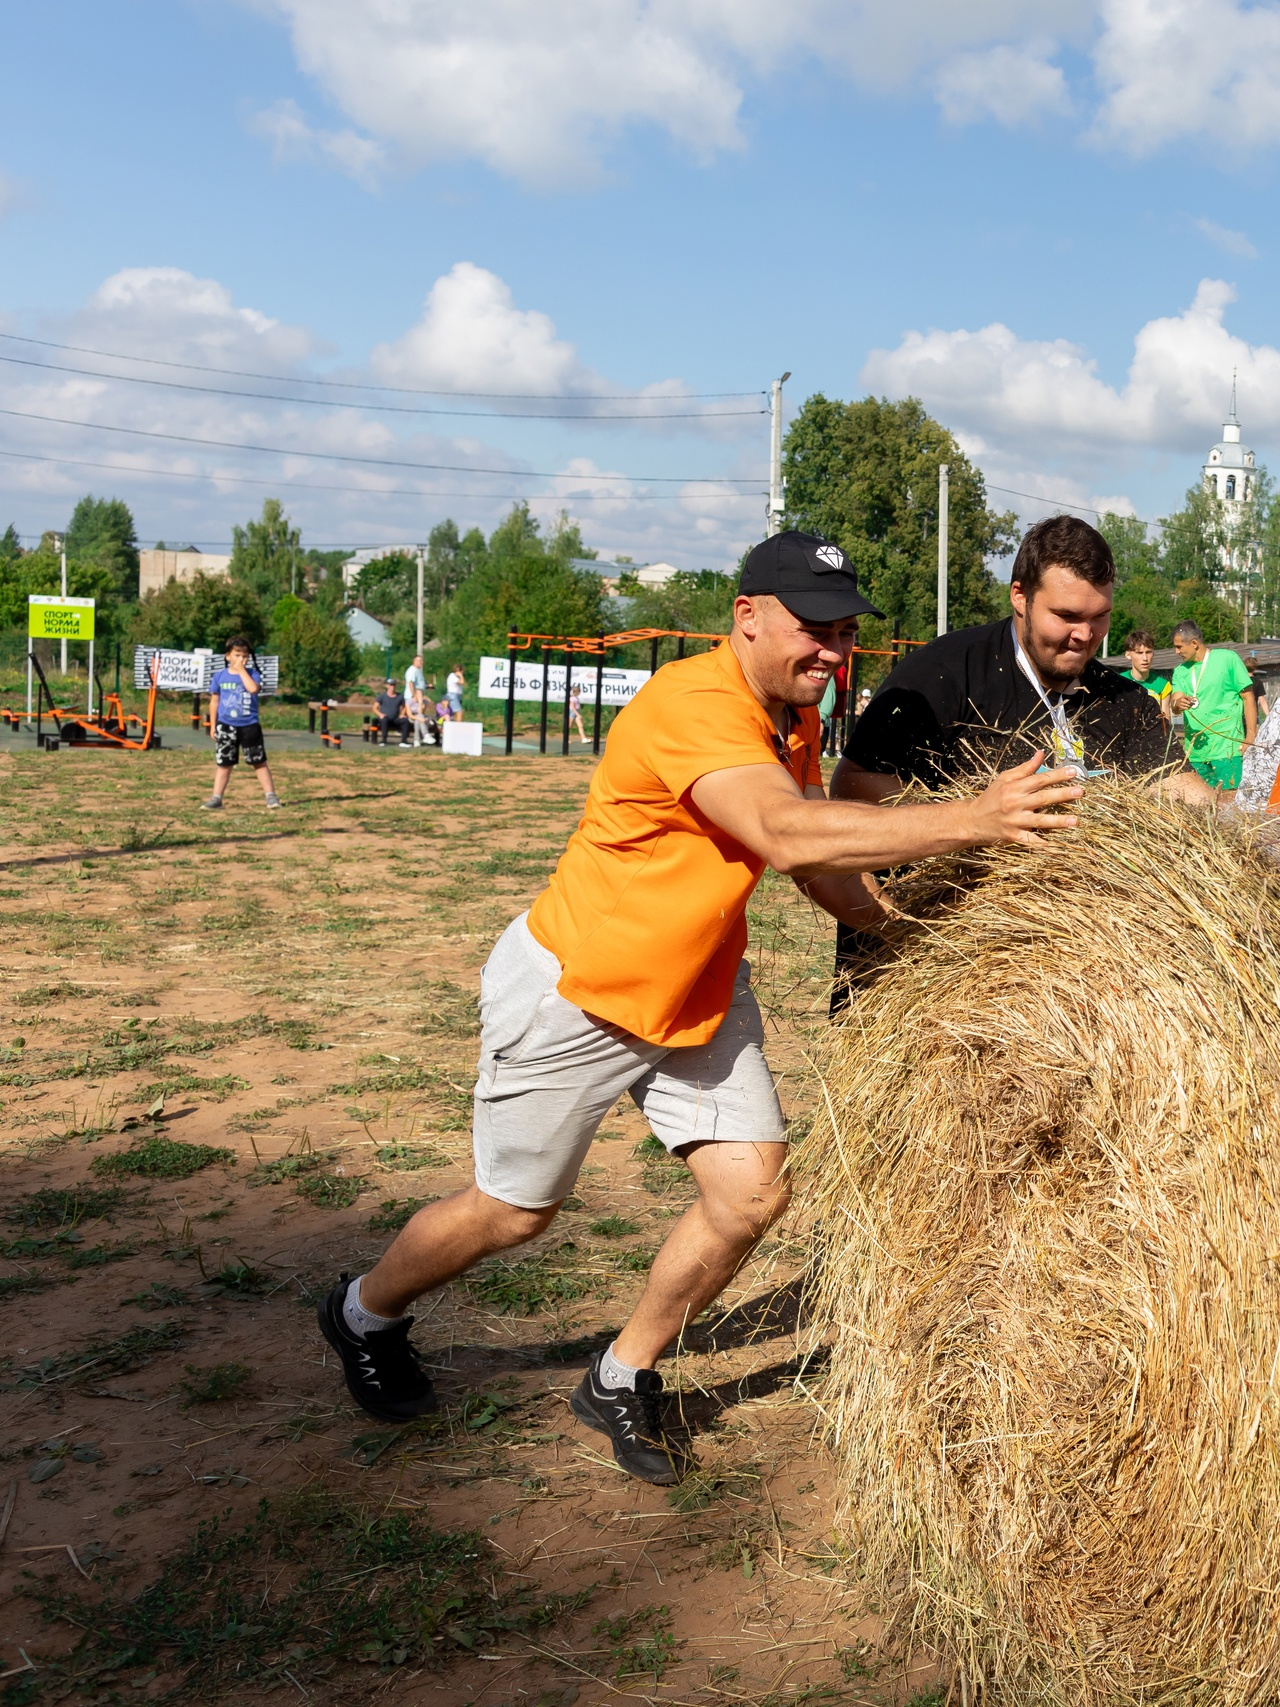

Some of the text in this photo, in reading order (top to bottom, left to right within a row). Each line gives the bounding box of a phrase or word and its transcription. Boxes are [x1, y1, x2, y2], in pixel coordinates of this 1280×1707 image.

[44, 610, 73, 619] СПОРТ
[44, 619, 80, 627] НОРМА
[44, 627, 80, 635] ЖИЗНИ
[160, 673, 198, 684] ЖИЗНИ
[490, 676, 526, 689] ДЕНЬ
